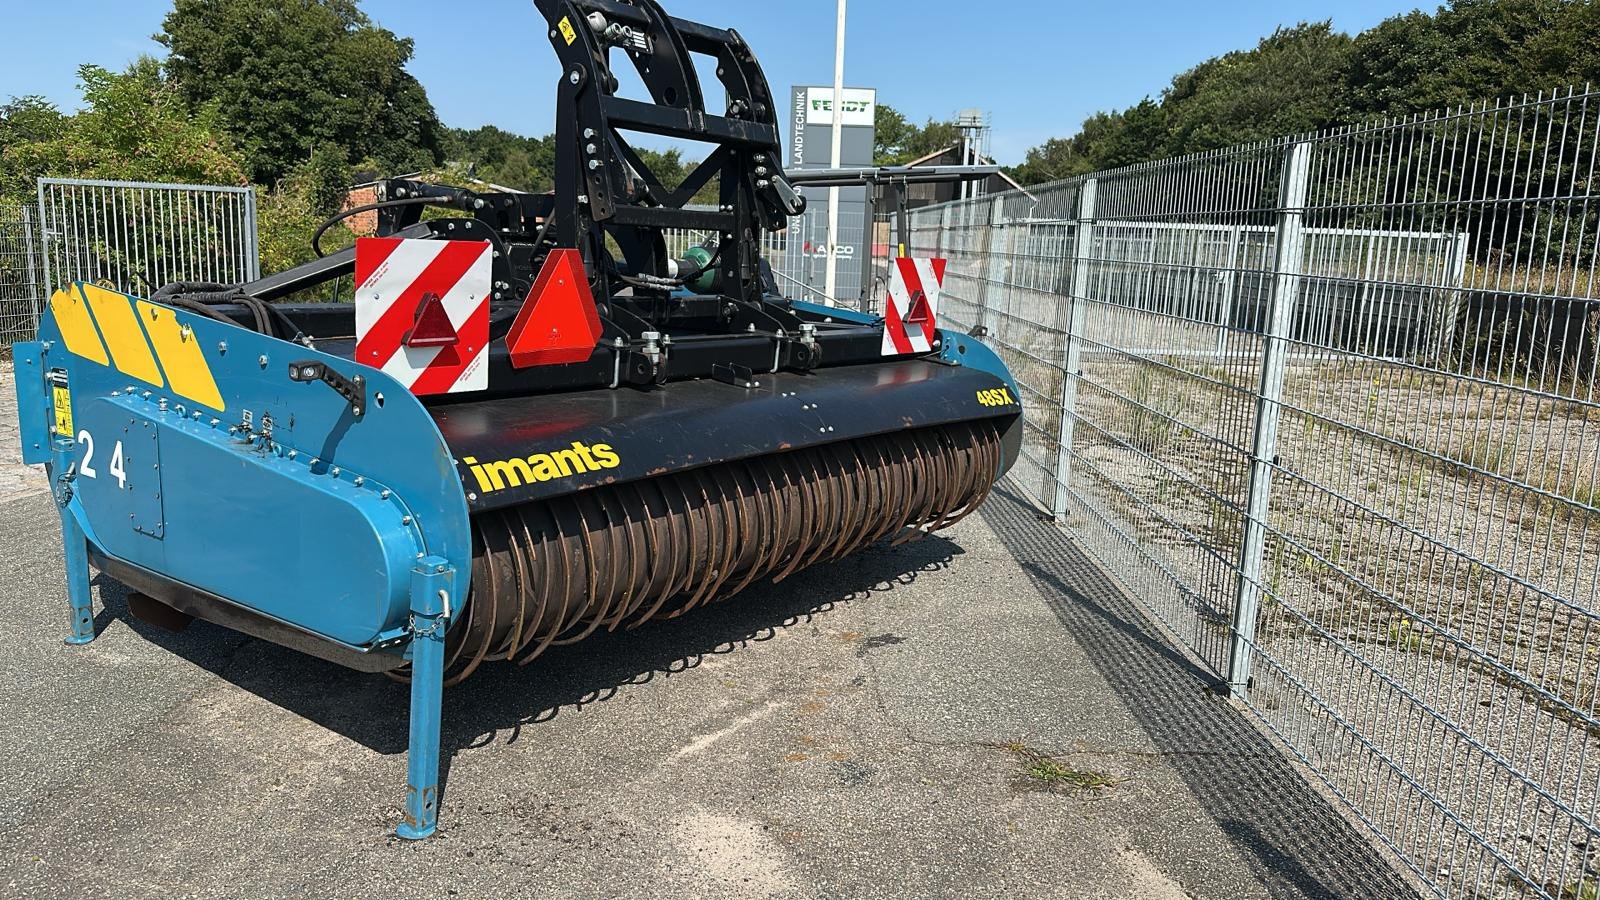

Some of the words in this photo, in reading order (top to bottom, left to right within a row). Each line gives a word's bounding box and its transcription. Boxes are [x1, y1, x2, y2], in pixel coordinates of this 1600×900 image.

[794, 92, 805, 165] LANDTECHNIK
[817, 245, 853, 254] ACO
[976, 388, 1014, 407] 48SX
[463, 441, 620, 493] imants
